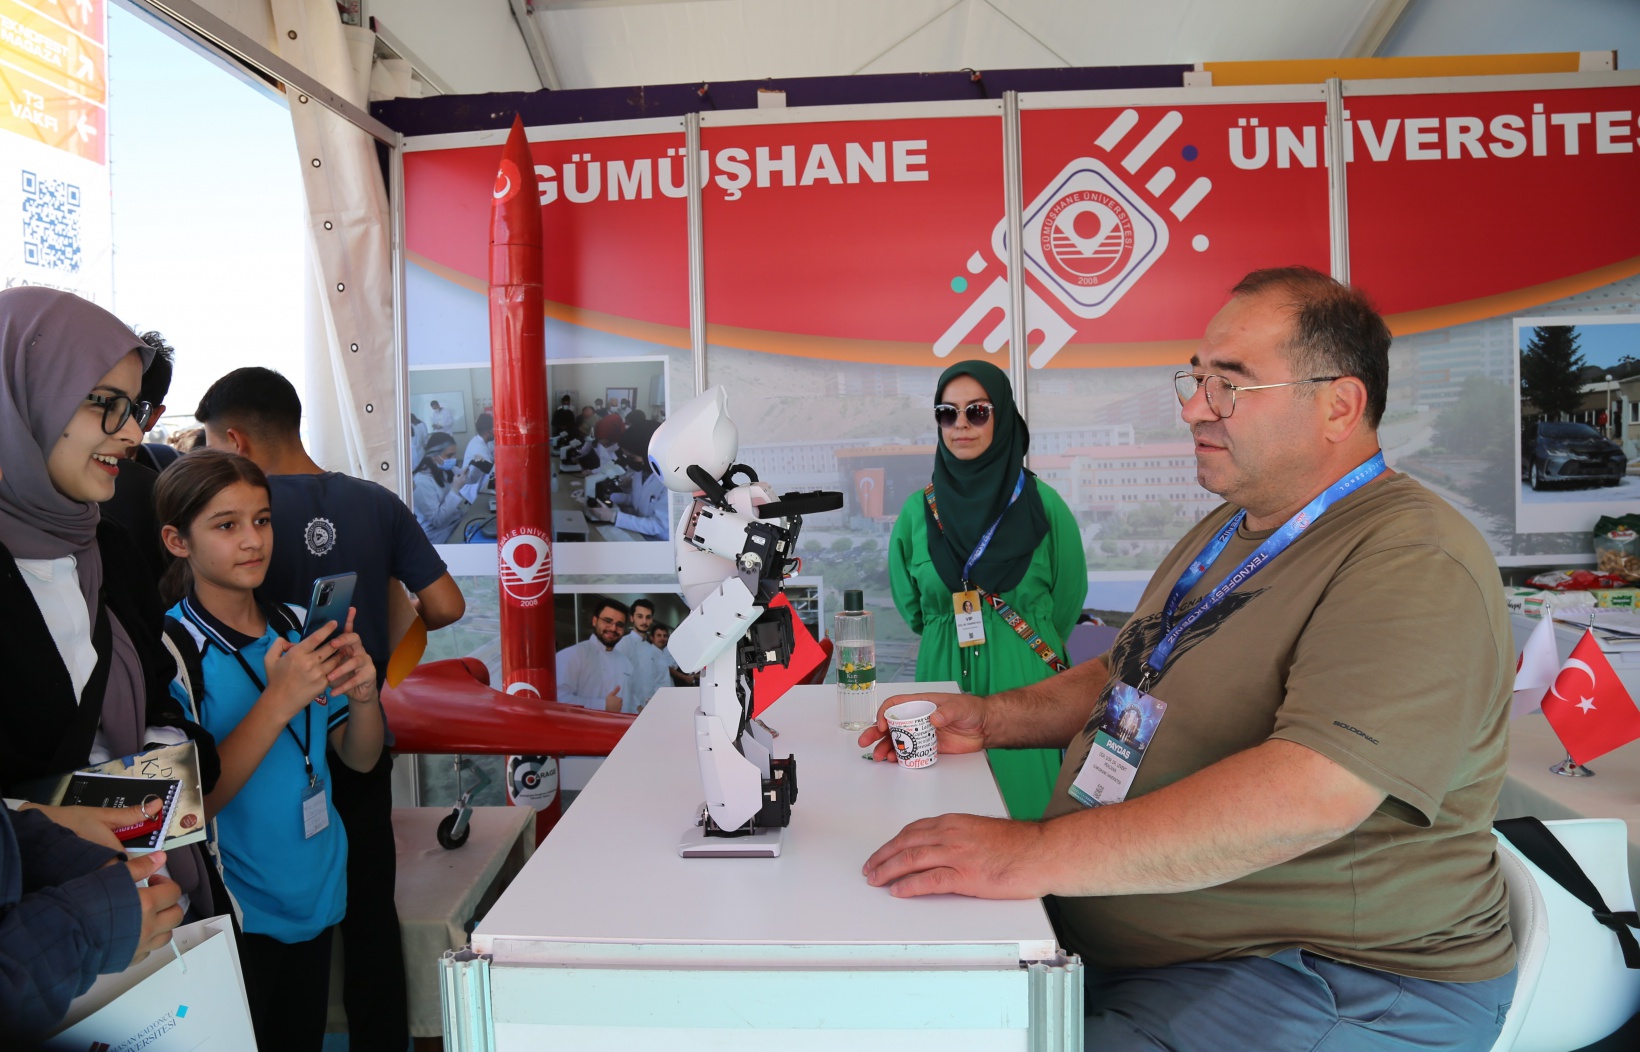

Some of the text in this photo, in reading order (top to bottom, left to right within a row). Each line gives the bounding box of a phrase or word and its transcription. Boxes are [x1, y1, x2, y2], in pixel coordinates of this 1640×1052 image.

[0, 14, 69, 57] EKNOFEST
[534, 103, 1640, 206] GÜMÜŞHANE ÜNİVERSİTE
[1042, 192, 1133, 251] GÜMÜŞHANE ÜNİVERSİTESİ
[1078, 277, 1098, 285] 2008
[1211, 552, 1269, 604] TEKNOFEST
[520, 599, 538, 607] 2008
[904, 757, 930, 768] Coffee
